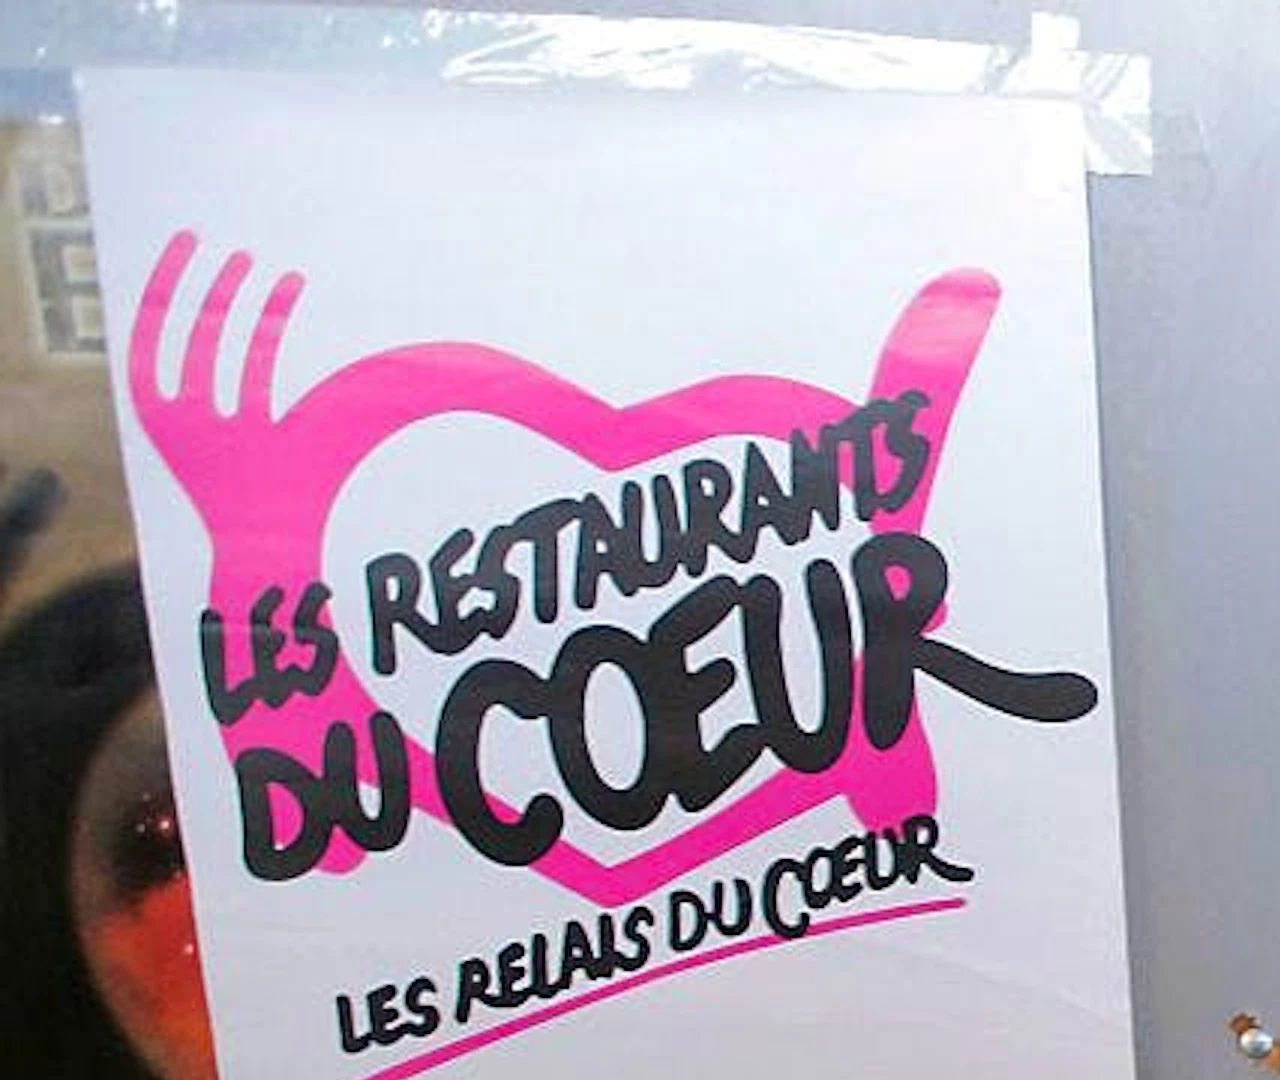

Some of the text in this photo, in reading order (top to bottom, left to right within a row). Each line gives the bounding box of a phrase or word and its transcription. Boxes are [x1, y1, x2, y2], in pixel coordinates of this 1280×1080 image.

[200, 388, 934, 726] LES RESTAURANTS
[233, 713, 412, 882] DU
[336, 984, 442, 1053] LES
[454, 905, 657, 1024] RELAIS
[669, 877, 755, 952] DU
